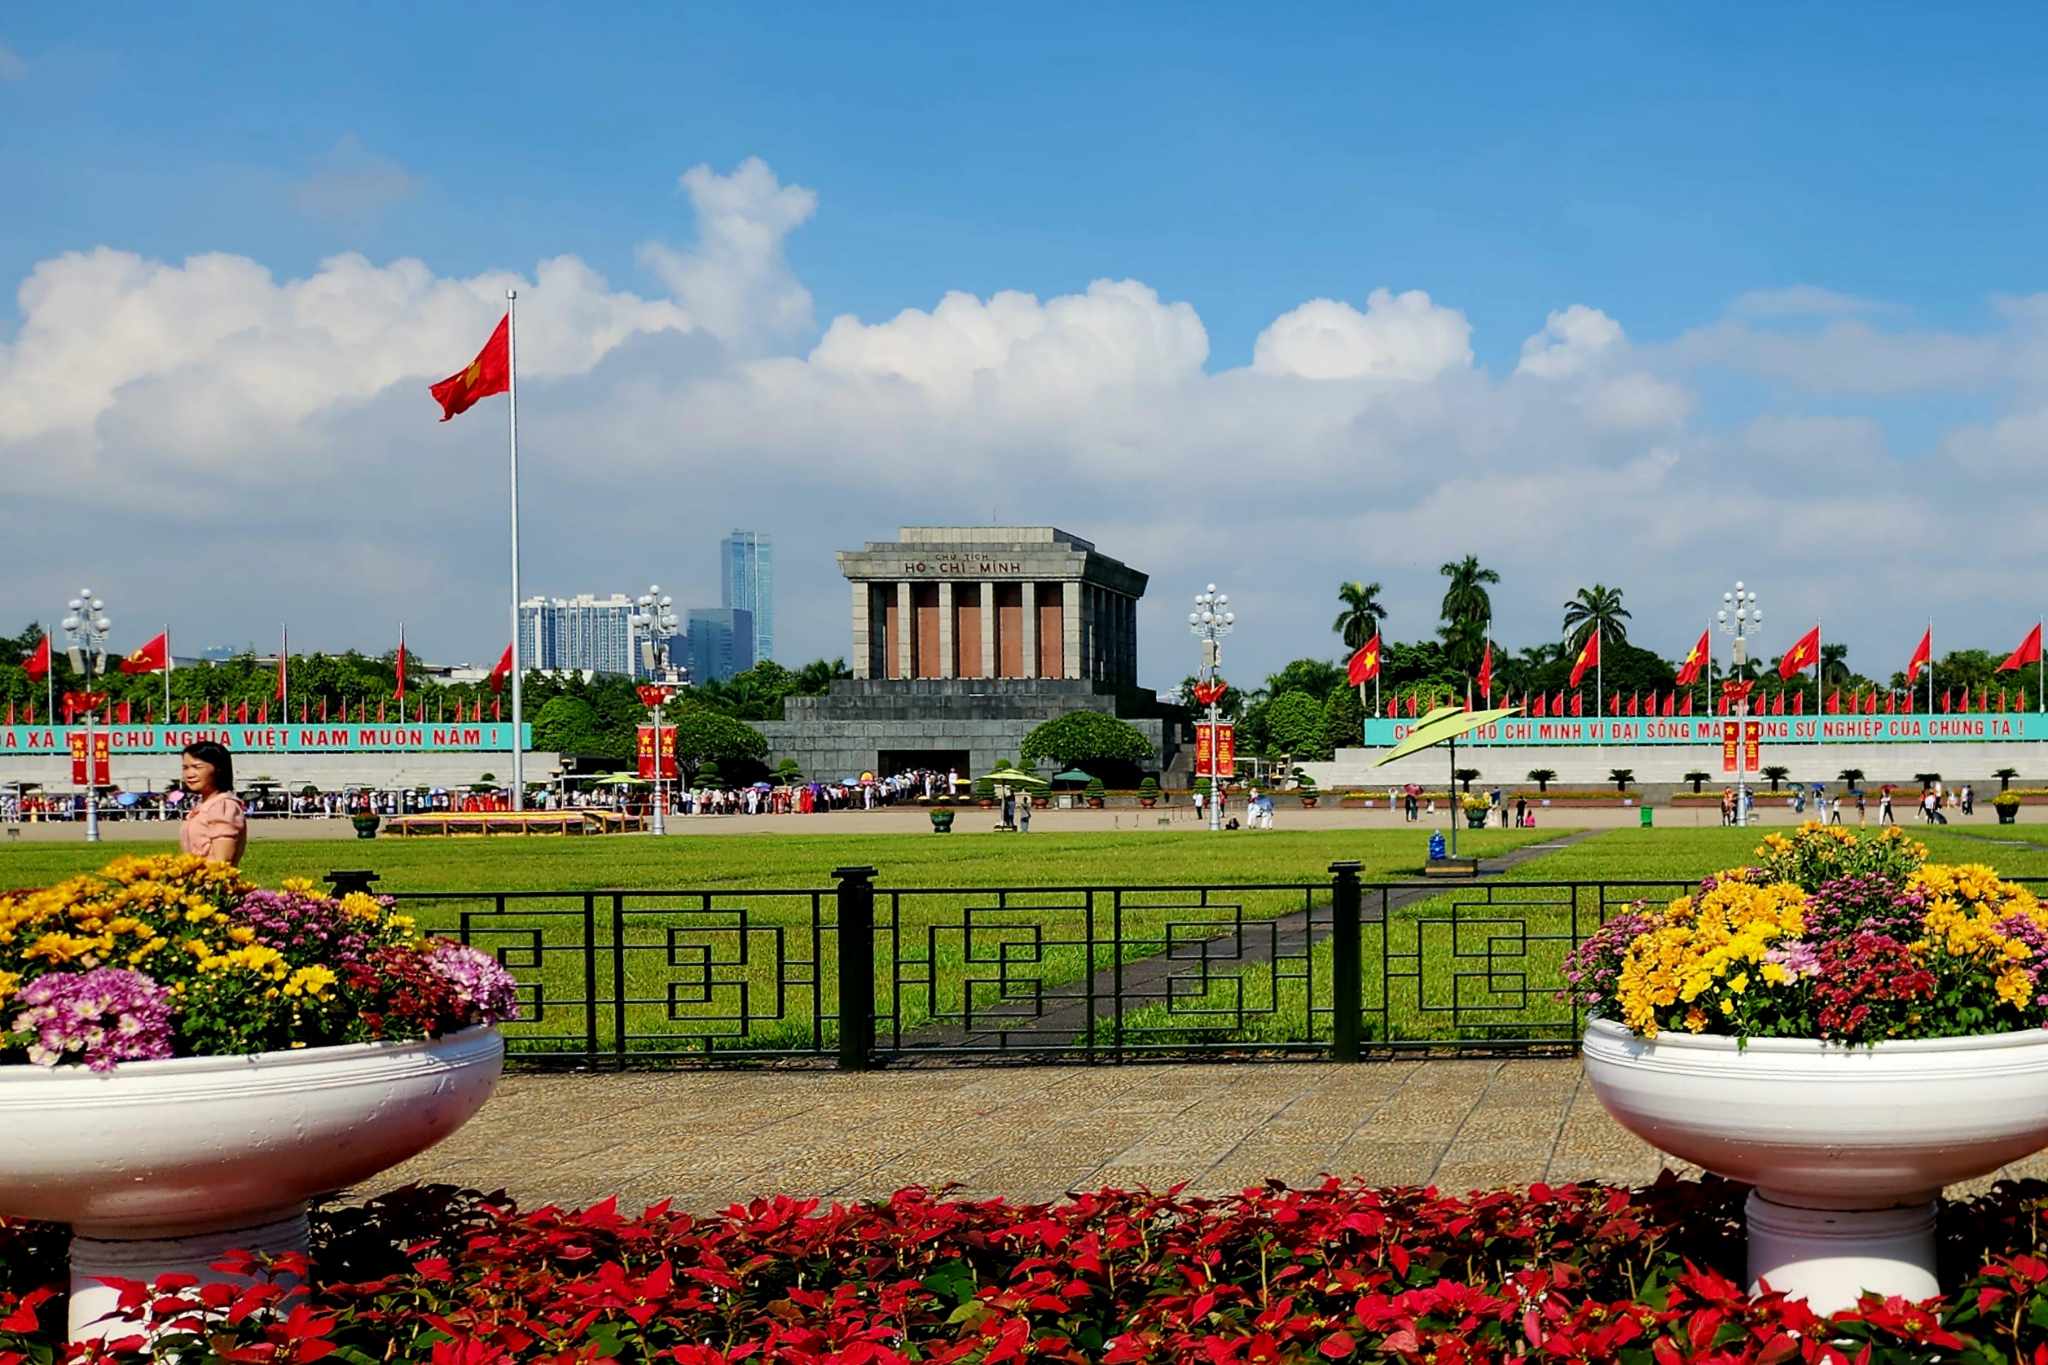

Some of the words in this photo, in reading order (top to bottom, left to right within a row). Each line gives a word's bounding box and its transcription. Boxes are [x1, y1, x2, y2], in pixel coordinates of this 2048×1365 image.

[243, 726, 289, 750] VIỆT
[301, 729, 348, 746] NAM
[360, 726, 422, 746] MUÔN
[1540, 723, 1582, 740] MINH
[1824, 718, 1883, 740] NGHIỆP
[1991, 719, 2011, 736] TA
